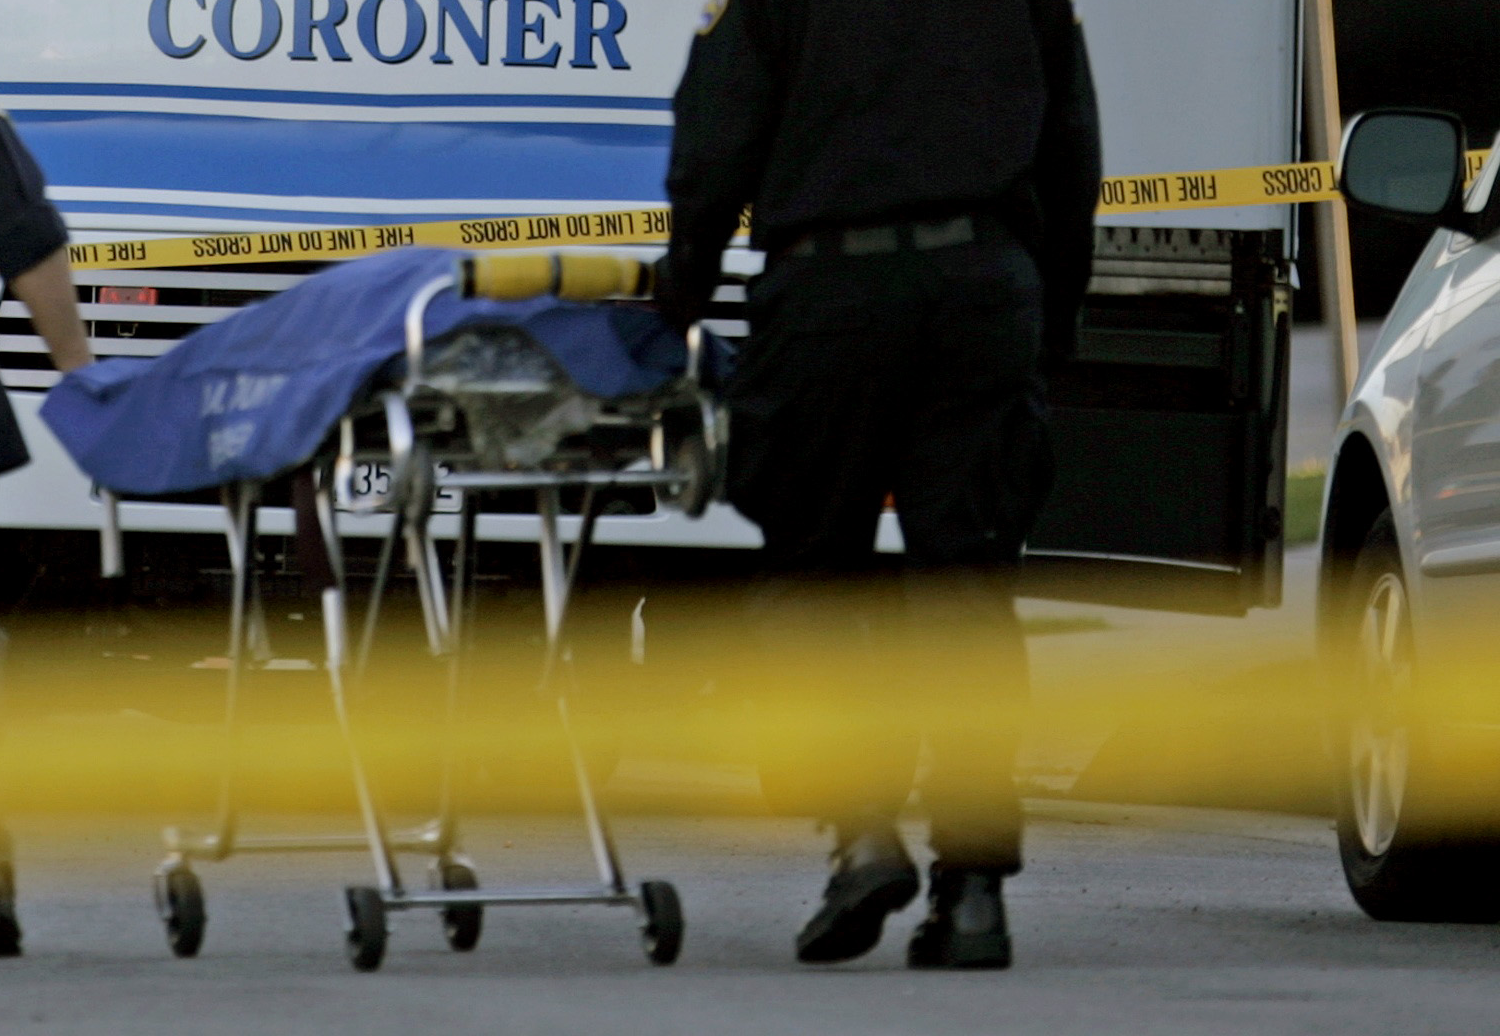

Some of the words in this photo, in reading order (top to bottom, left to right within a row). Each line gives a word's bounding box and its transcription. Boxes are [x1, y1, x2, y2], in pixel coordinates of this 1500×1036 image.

[1102, 179, 1126, 205] DO
[1130, 177, 1170, 205] LINE
[1176, 175, 1218, 202] FIRE
[1262, 166, 1323, 196] CROSS
[460, 219, 520, 244] CROSS
[526, 217, 561, 240] NOT
[567, 214, 591, 237] DO
[596, 212, 635, 236] LINE
[643, 211, 671, 234] IRE
[191, 234, 252, 258] CROSS
[258, 232, 293, 255] NOT
[300, 230, 322, 252] DO
[328, 228, 367, 251] LINE
[375, 226, 415, 249] FIRE
[67, 243, 99, 264] LIN
[107, 242, 147, 263] FIRE
